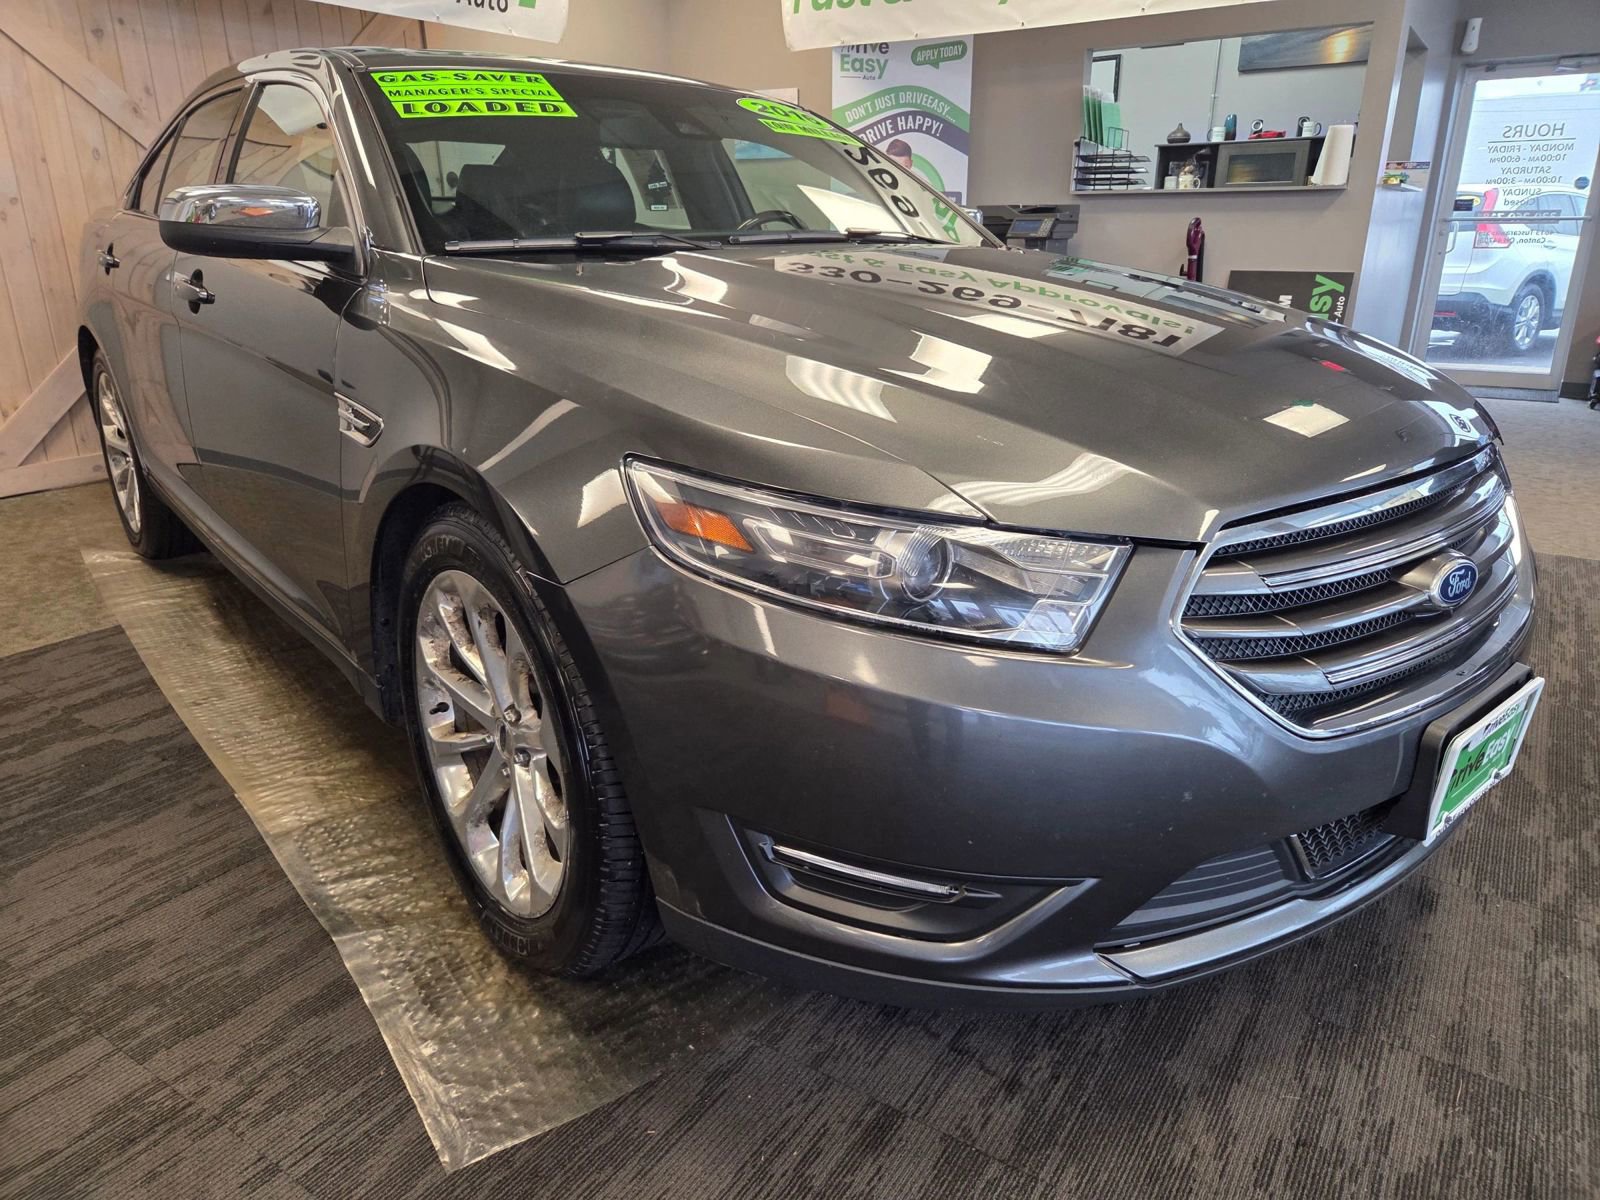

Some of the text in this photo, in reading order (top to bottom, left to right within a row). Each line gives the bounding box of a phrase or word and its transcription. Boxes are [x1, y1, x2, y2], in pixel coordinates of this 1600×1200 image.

[917, 44, 963, 62] APPLY TODAY
[840, 54, 888, 80] Easy
[378, 73, 545, 84] GAS-SAVER
[388, 86, 554, 97] MANAGER'S SPECIAL
[401, 101, 563, 115] LOADED
[844, 101, 872, 123] DON'T
[874, 93, 896, 109] JUST
[897, 115, 944, 136] HAPPY!
[1334, 296, 1346, 318] Auto
[1448, 569, 1471, 597] Ford
